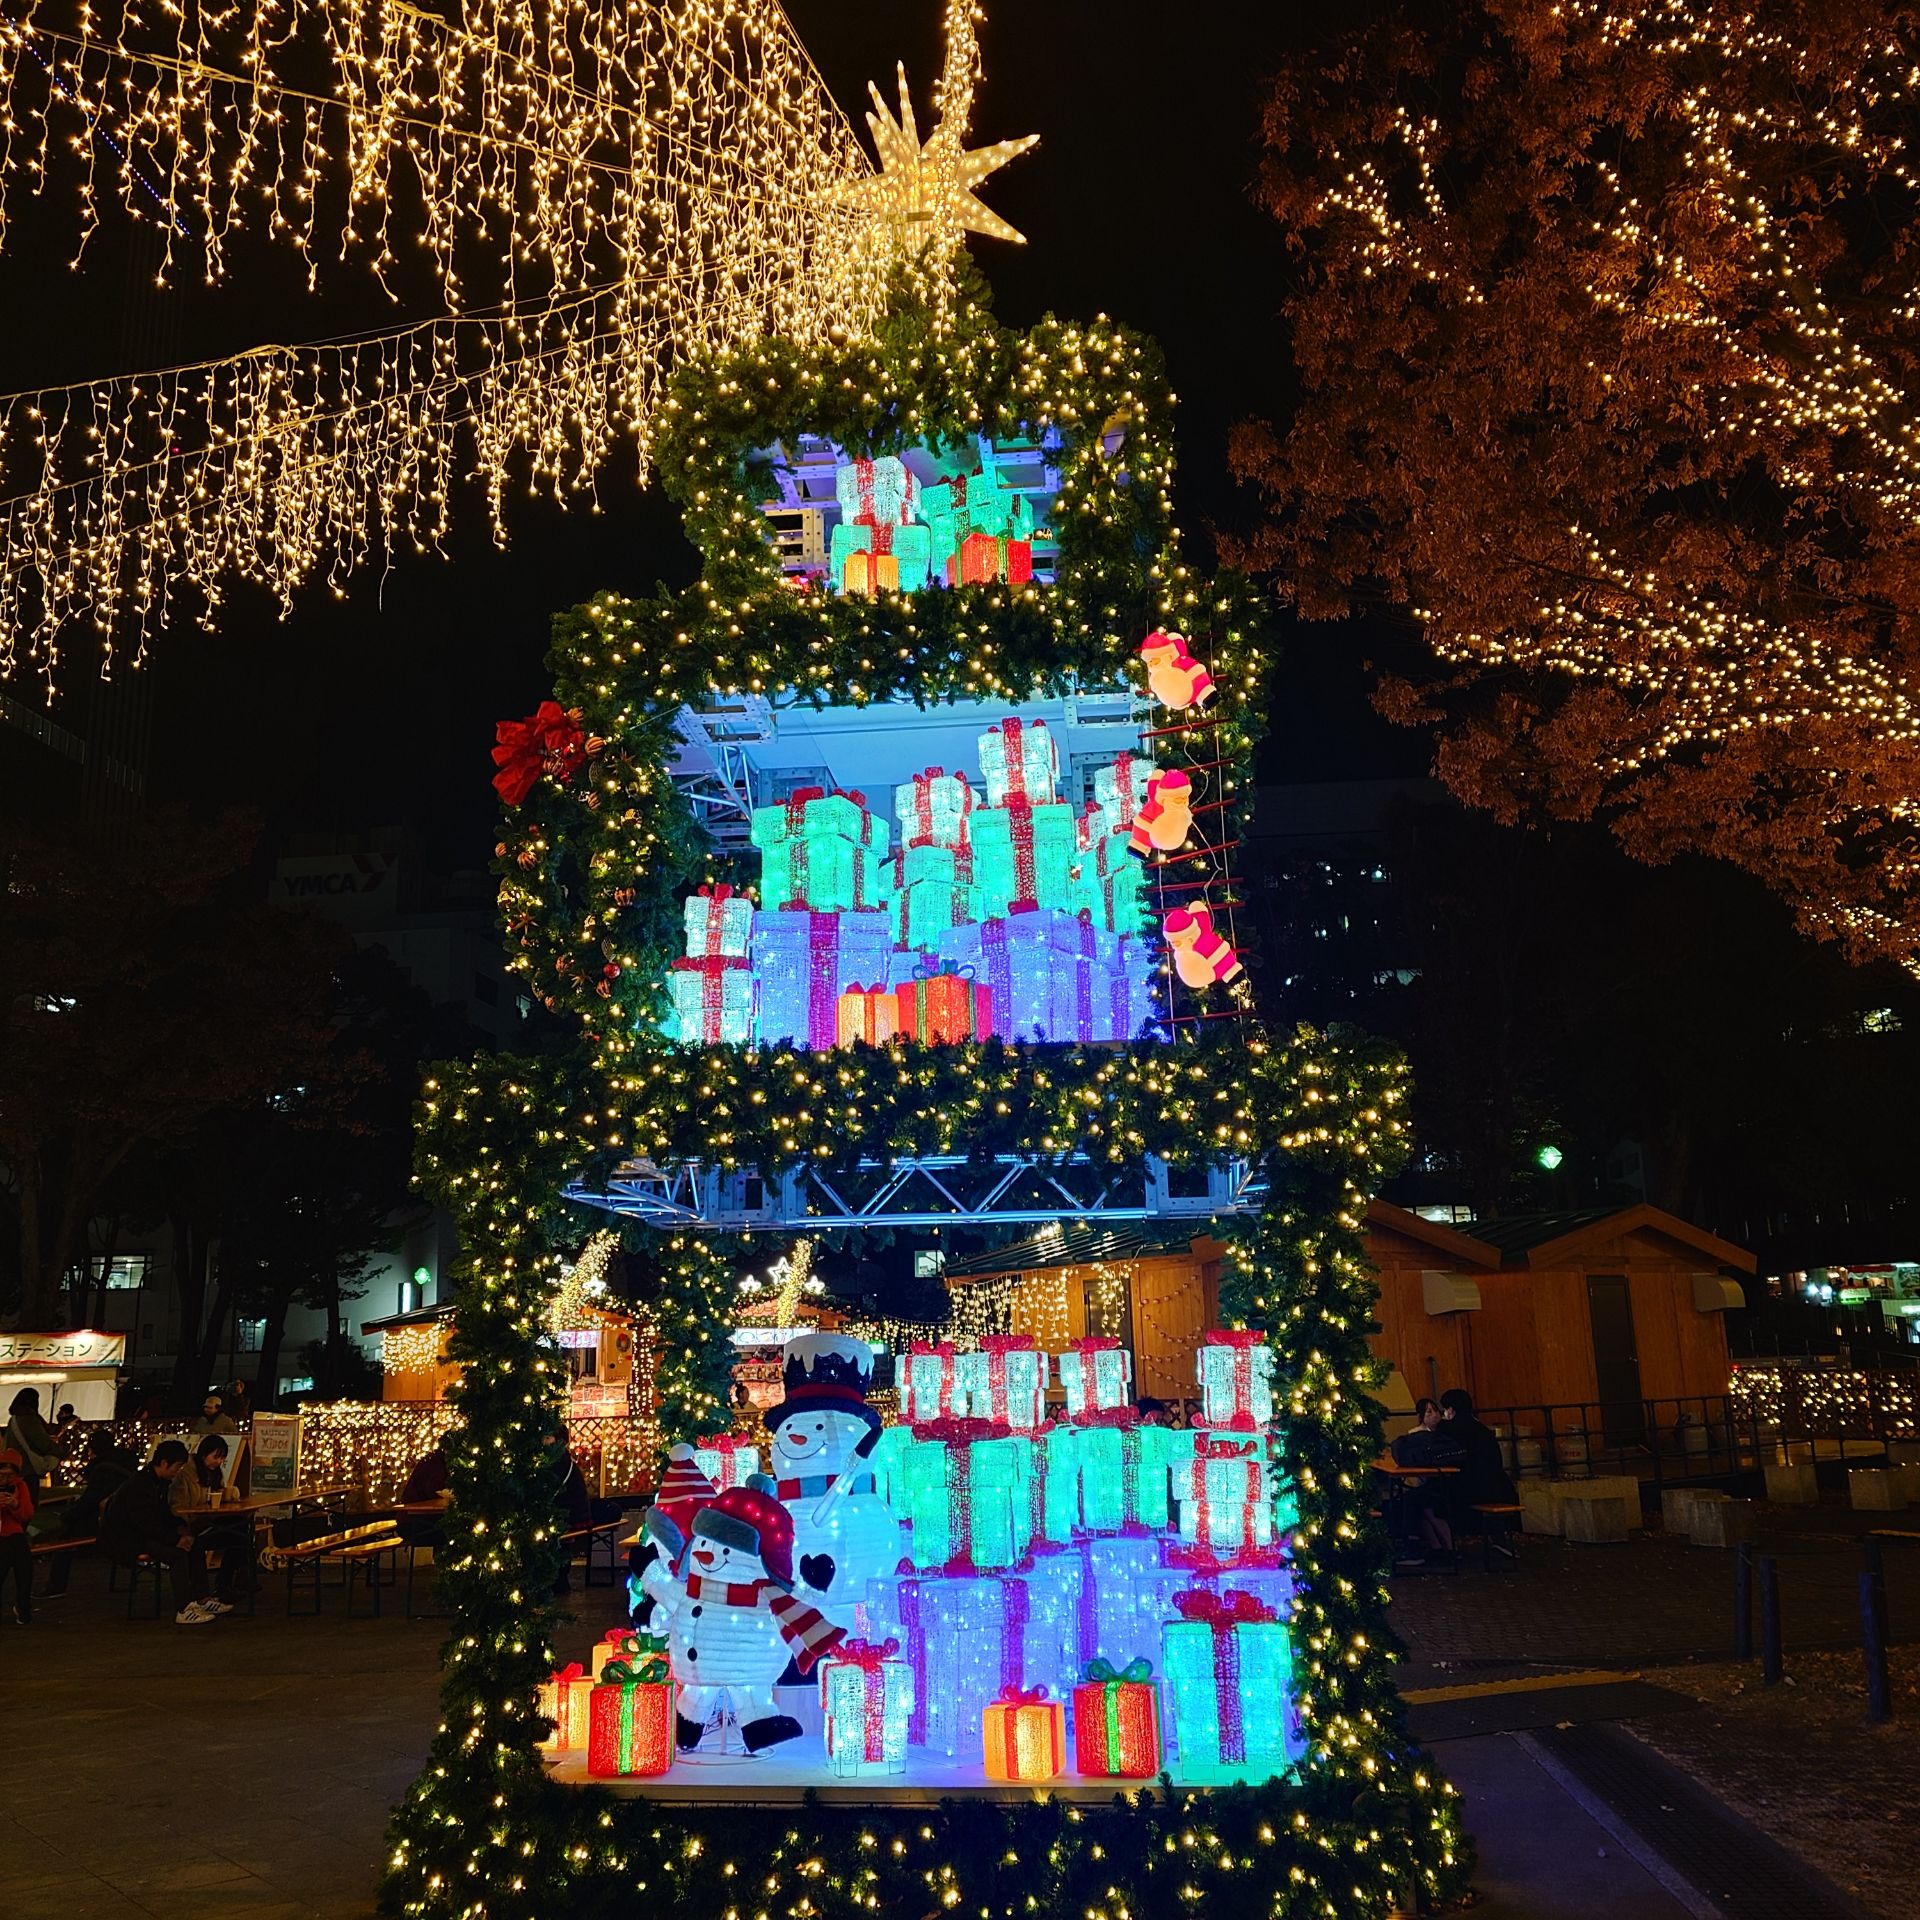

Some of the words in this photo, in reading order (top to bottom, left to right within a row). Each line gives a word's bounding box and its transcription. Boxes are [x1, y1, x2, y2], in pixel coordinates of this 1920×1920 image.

[284, 873, 359, 896] YMCA
[0, 1343, 93, 1358] ステーション
